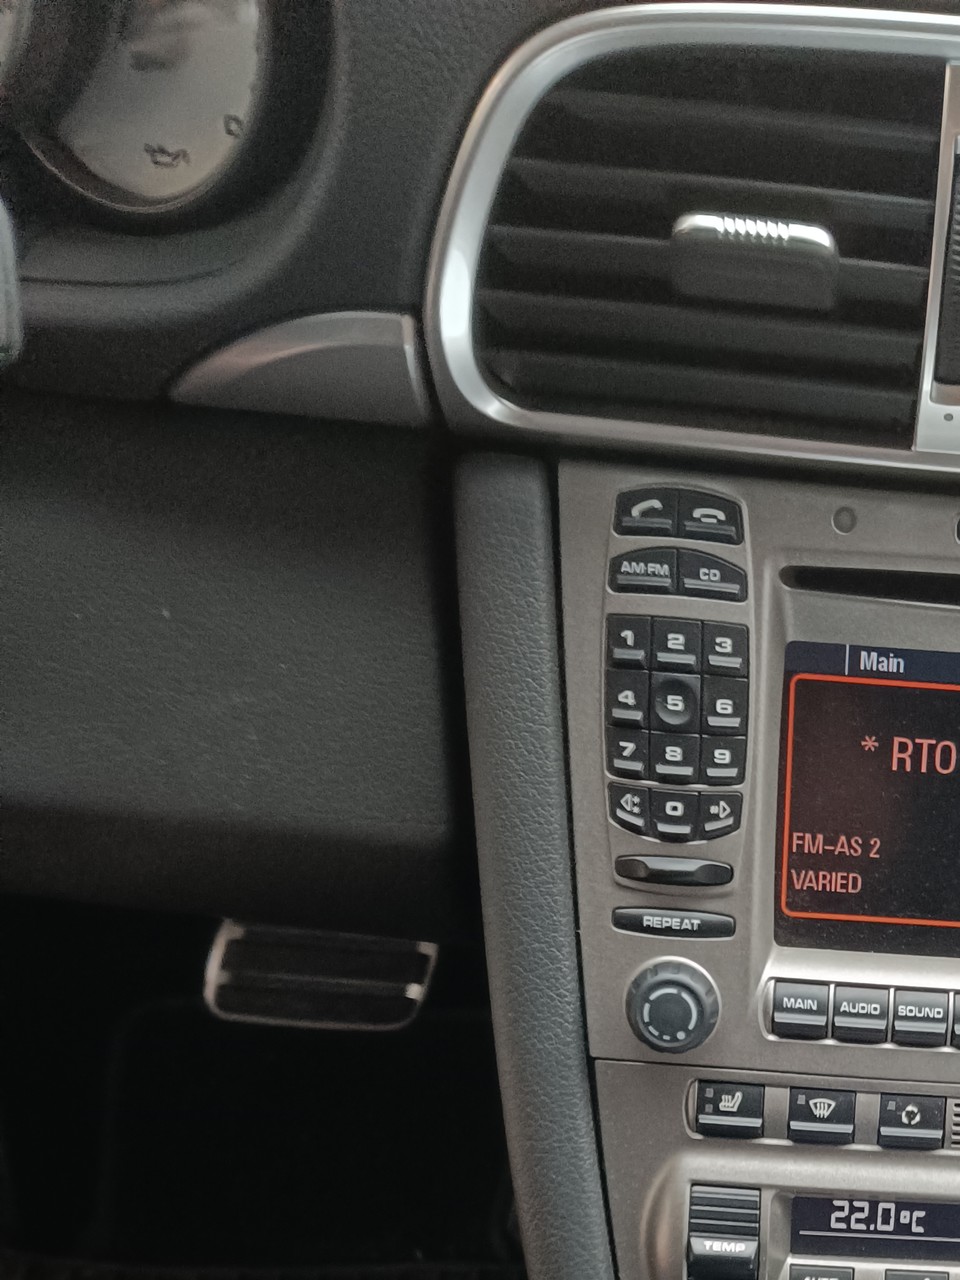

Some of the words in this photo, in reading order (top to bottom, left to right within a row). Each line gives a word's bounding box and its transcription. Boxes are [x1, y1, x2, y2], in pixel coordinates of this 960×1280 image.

[699, 567, 722, 581] CD
[620, 630, 635, 647] 1
[667, 633, 686, 651] 2
[715, 637, 733, 654] 3
[859, 650, 905, 674] Main
[617, 690, 637, 706] 4
[666, 694, 685, 712] 5
[716, 698, 734, 714] 6
[619, 741, 637, 757] 7
[665, 746, 683, 762] 8
[713, 749, 732, 764] 9
[891, 736, 958, 775] RTO
[792, 832, 863, 858] FM-AS
[869, 837, 881, 859] 2
[790, 869, 863, 895] VARIED
[642, 915, 702, 932] REPEAT
[782, 997, 818, 1012] MAIN
[840, 1001, 881, 1015] AUDIO
[897, 1005, 944, 1019] SOUND
[703, 1240, 746, 1253] TEMP
